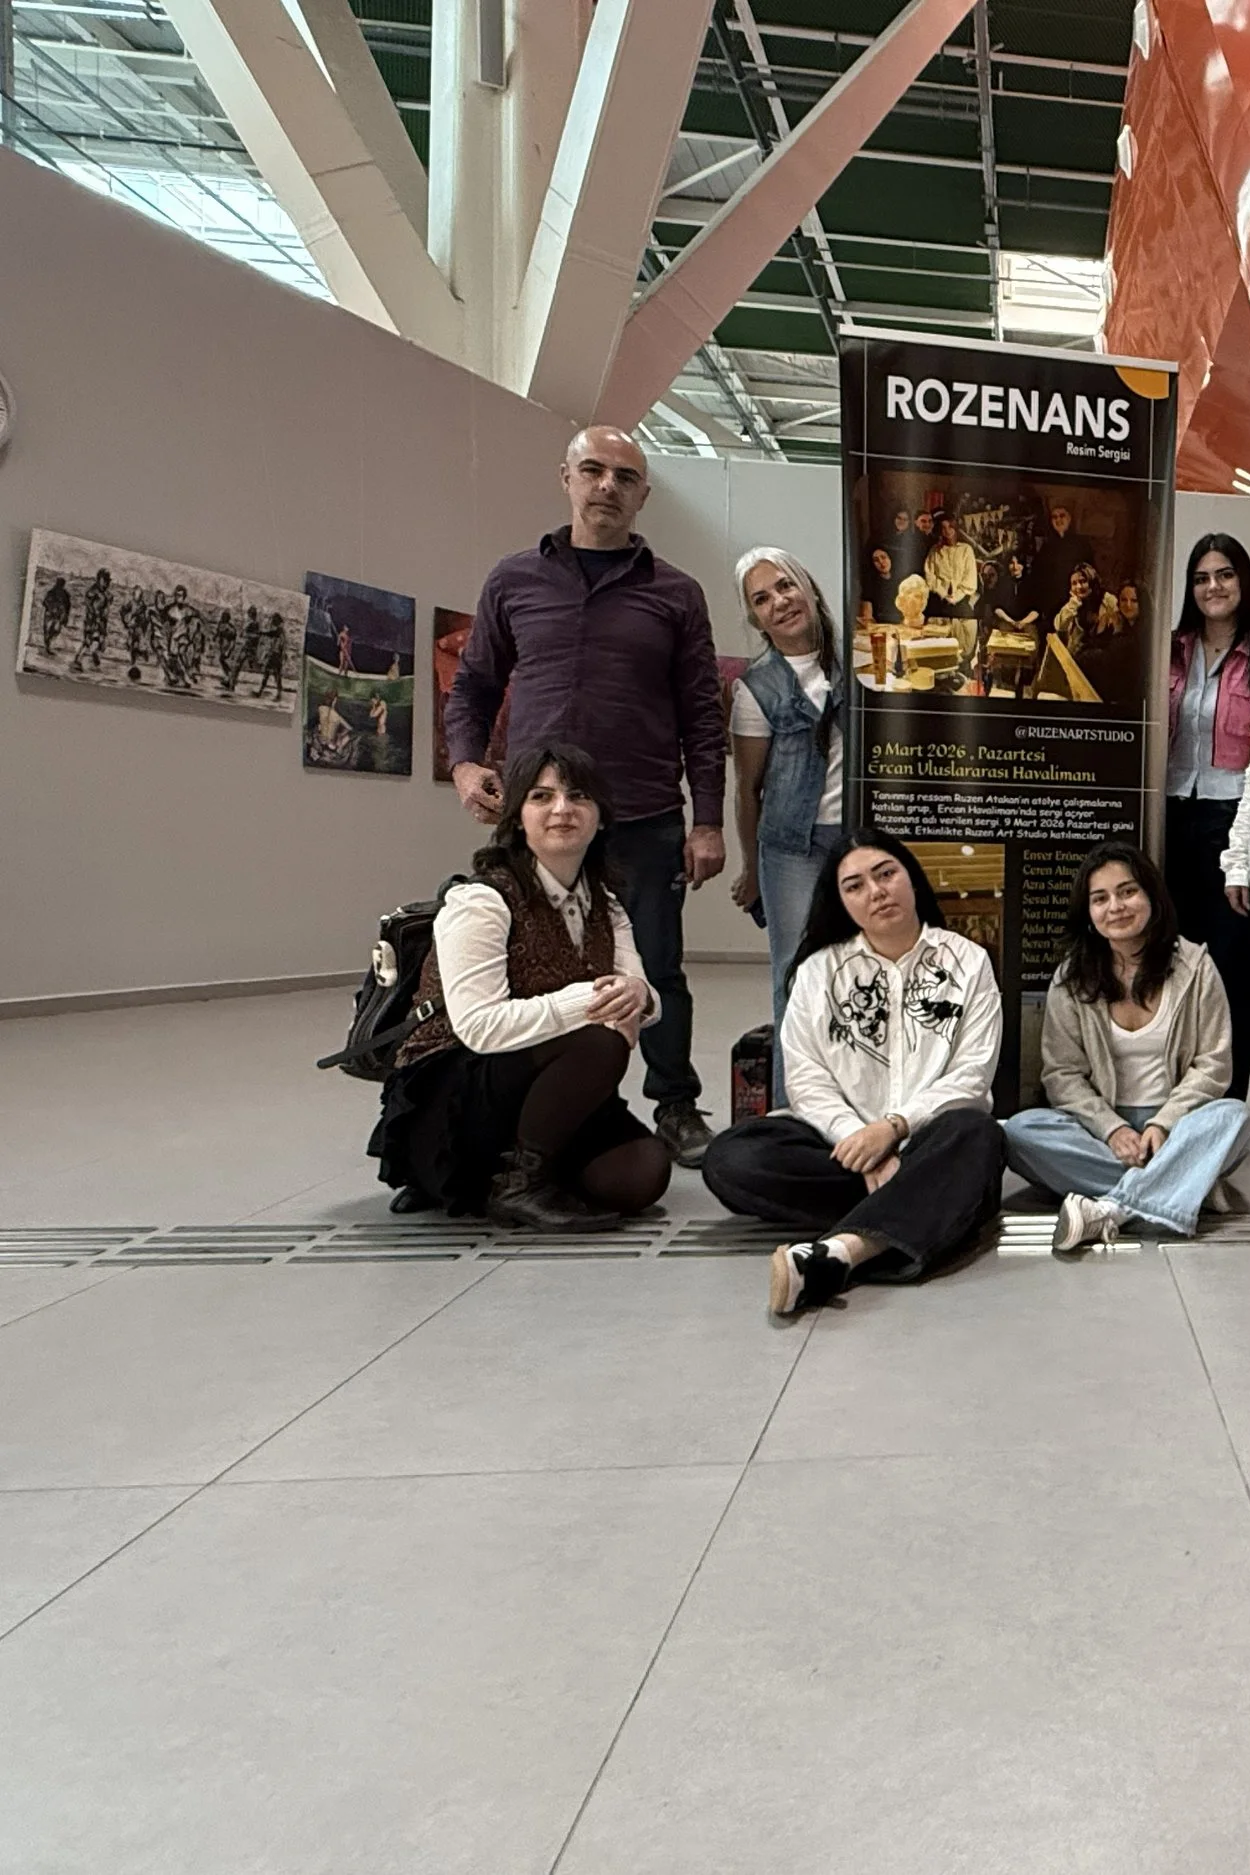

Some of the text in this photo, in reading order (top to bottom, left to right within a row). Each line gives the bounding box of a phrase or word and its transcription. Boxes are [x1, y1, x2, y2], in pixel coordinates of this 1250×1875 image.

[887, 375, 1131, 441] ROZENANS
[1066, 441, 1131, 463] Resim Sergisi
[1015, 725, 1135, 742] @RUZENARTSTUDIO
[872, 745, 882, 759] 9
[885, 742, 923, 757] Mart
[927, 743, 967, 759] 2026
[978, 746, 1046, 762] Pazartesi
[868, 759, 1097, 782] Ercan Uluslararası Havalimanı
[917, 793, 953, 802] ressam
[954, 793, 984, 803] Ruzen
[937, 804, 966, 814] Ercan
[1039, 808, 1063, 819] sergi
[874, 813, 920, 824] Rezonans
[940, 815, 973, 826] verilen
[1004, 817, 1012, 827] 9
[1013, 818, 1037, 828] Mart
[1040, 818, 1065, 829] 2026
[1067, 819, 1110, 830] Pazartesi
[1112, 821, 1135, 833] günü
[915, 825, 963, 837] Etkinlikte
[965, 827, 994, 838] Ruzen
[996, 828, 1014, 839] Art
[1016, 829, 1048, 840] Studio
